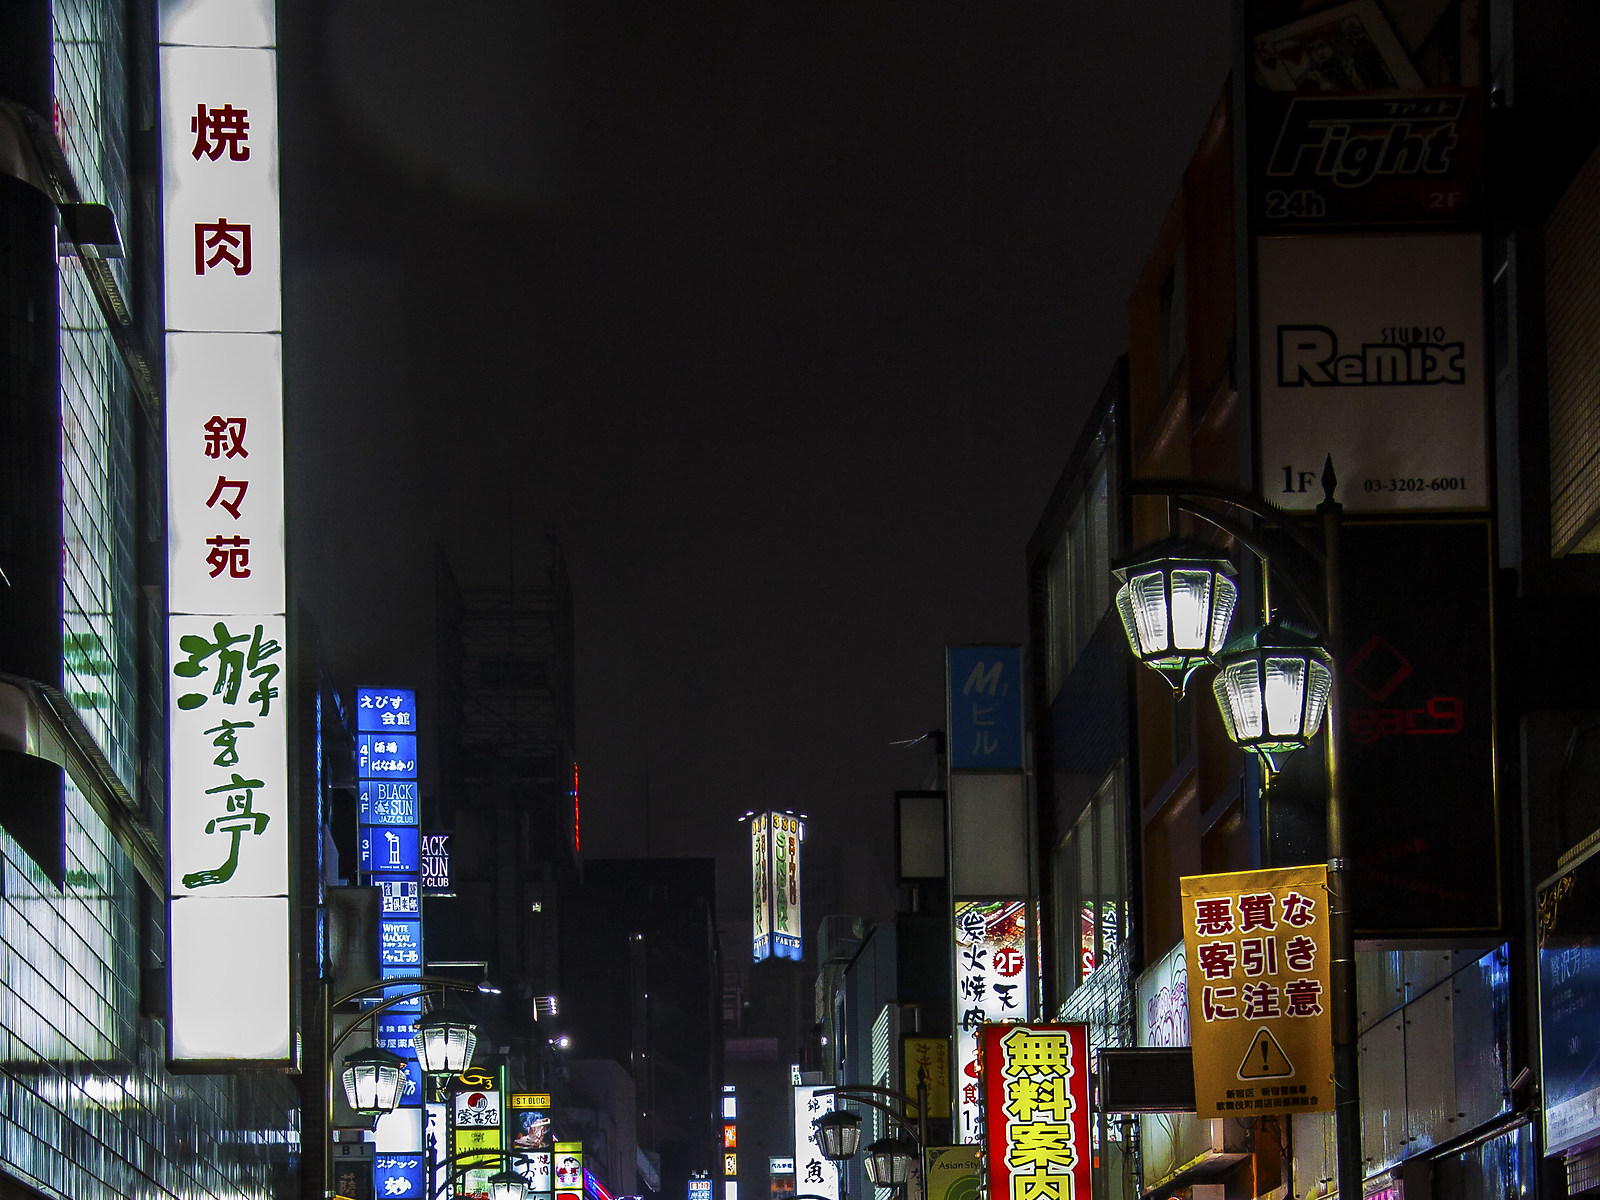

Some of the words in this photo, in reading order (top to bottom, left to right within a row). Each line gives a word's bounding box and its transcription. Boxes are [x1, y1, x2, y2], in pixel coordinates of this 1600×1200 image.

[1267, 96, 1464, 187] Fight
[189, 102, 253, 276] 焼肉
[1266, 191, 1325, 217] 24h
[1430, 192, 1460, 208] 2F
[1381, 327, 1445, 343] STUDIO
[1282, 466, 1316, 494] 1F
[1364, 477, 1467, 493] 03-3202-6001
[202, 414, 251, 580] 叙々苑
[360, 695, 403, 710] えびす
[381, 712, 411, 726] 会館
[360, 745, 369, 767] 4F
[378, 784, 413, 800] BLACK
[360, 792, 369, 814] 4F
[391, 800, 413, 816] SUN
[362, 840, 370, 861] 3F
[421, 836, 449, 856] ACK
[426, 877, 449, 888] CLUB
[1194, 892, 1317, 937] 悪質な
[996, 952, 1023, 975] 2F
[1197, 934, 1318, 981] 客引き
[1202, 977, 1324, 1022] に注意
[377, 1159, 418, 1170] スナック
[939, 1161, 963, 1170] Asian
[384, 1177, 412, 1197] 妙
